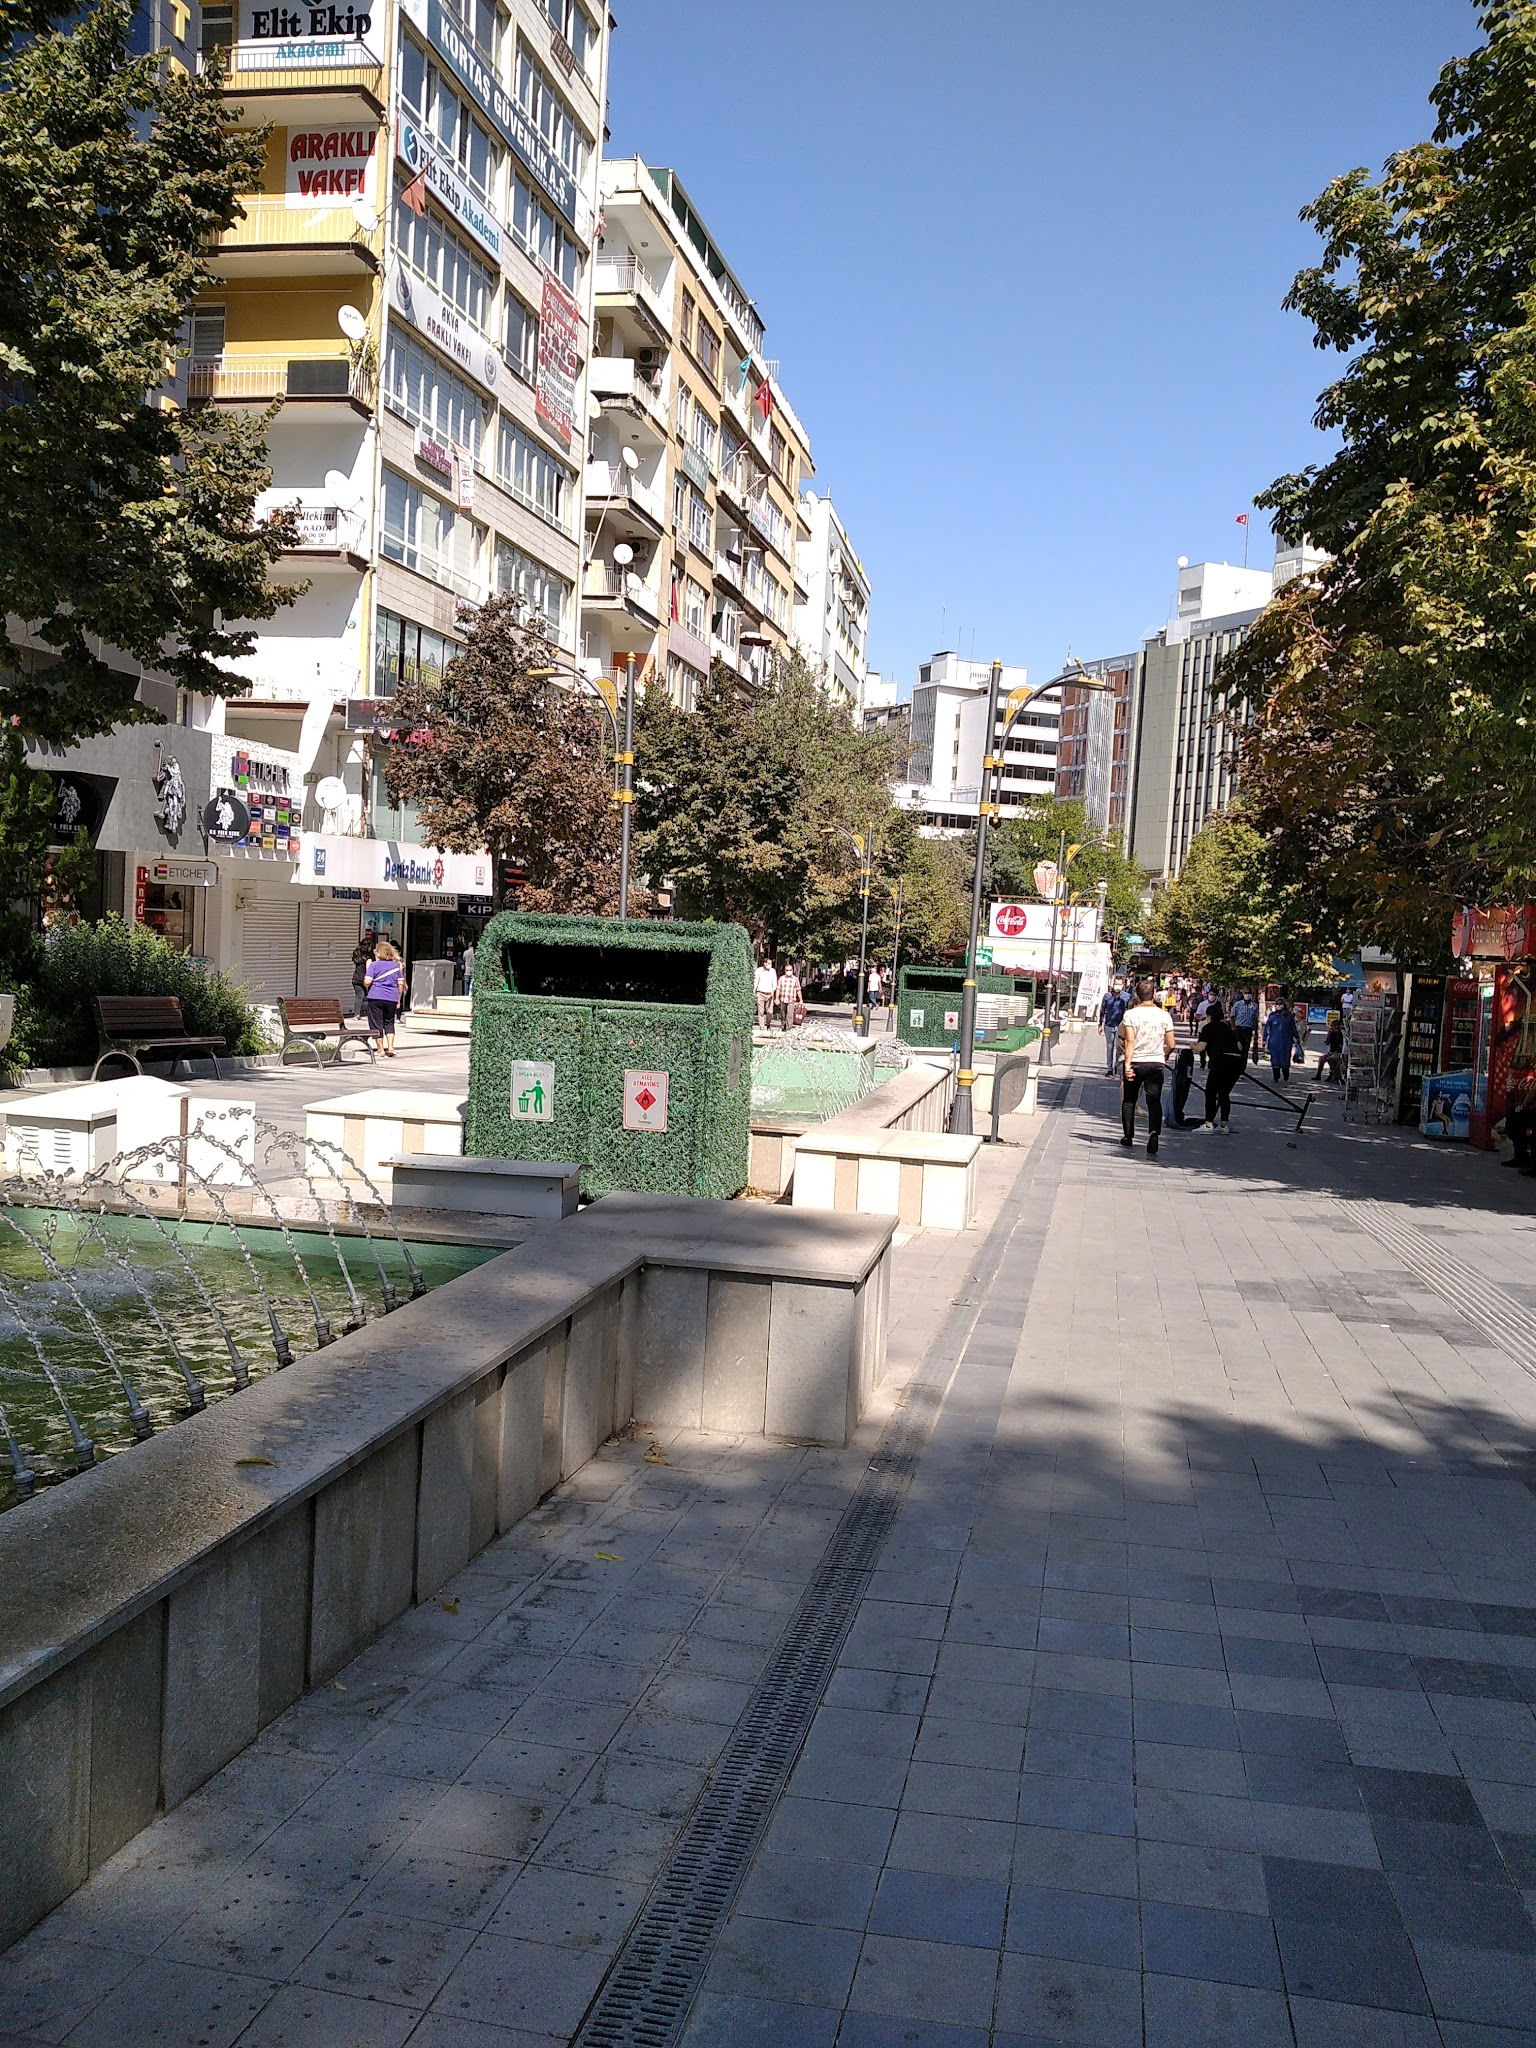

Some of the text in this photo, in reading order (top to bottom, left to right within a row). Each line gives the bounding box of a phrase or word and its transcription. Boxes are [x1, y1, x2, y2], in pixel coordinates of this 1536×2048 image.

[252, 4, 372, 41] Elit Ekip
[275, 39, 345, 58] Akademi
[440, 15, 491, 107] KORTAŞ
[493, 91, 548, 178] GÜVENLİK
[290, 130, 376, 162] ARAKLI
[297, 168, 366, 198] VAKFI
[439, 168, 461, 214] Ekip
[461, 196, 500, 253] Akademi
[441, 306, 459, 333] AKVA
[427, 315, 472, 365] ARAKLI VAKFI
[317, 851, 325, 863] 24
[385, 857, 431, 882] DenizBank
[168, 867, 209, 879] ETICHET
[332, 887, 362, 900] DenizBank
